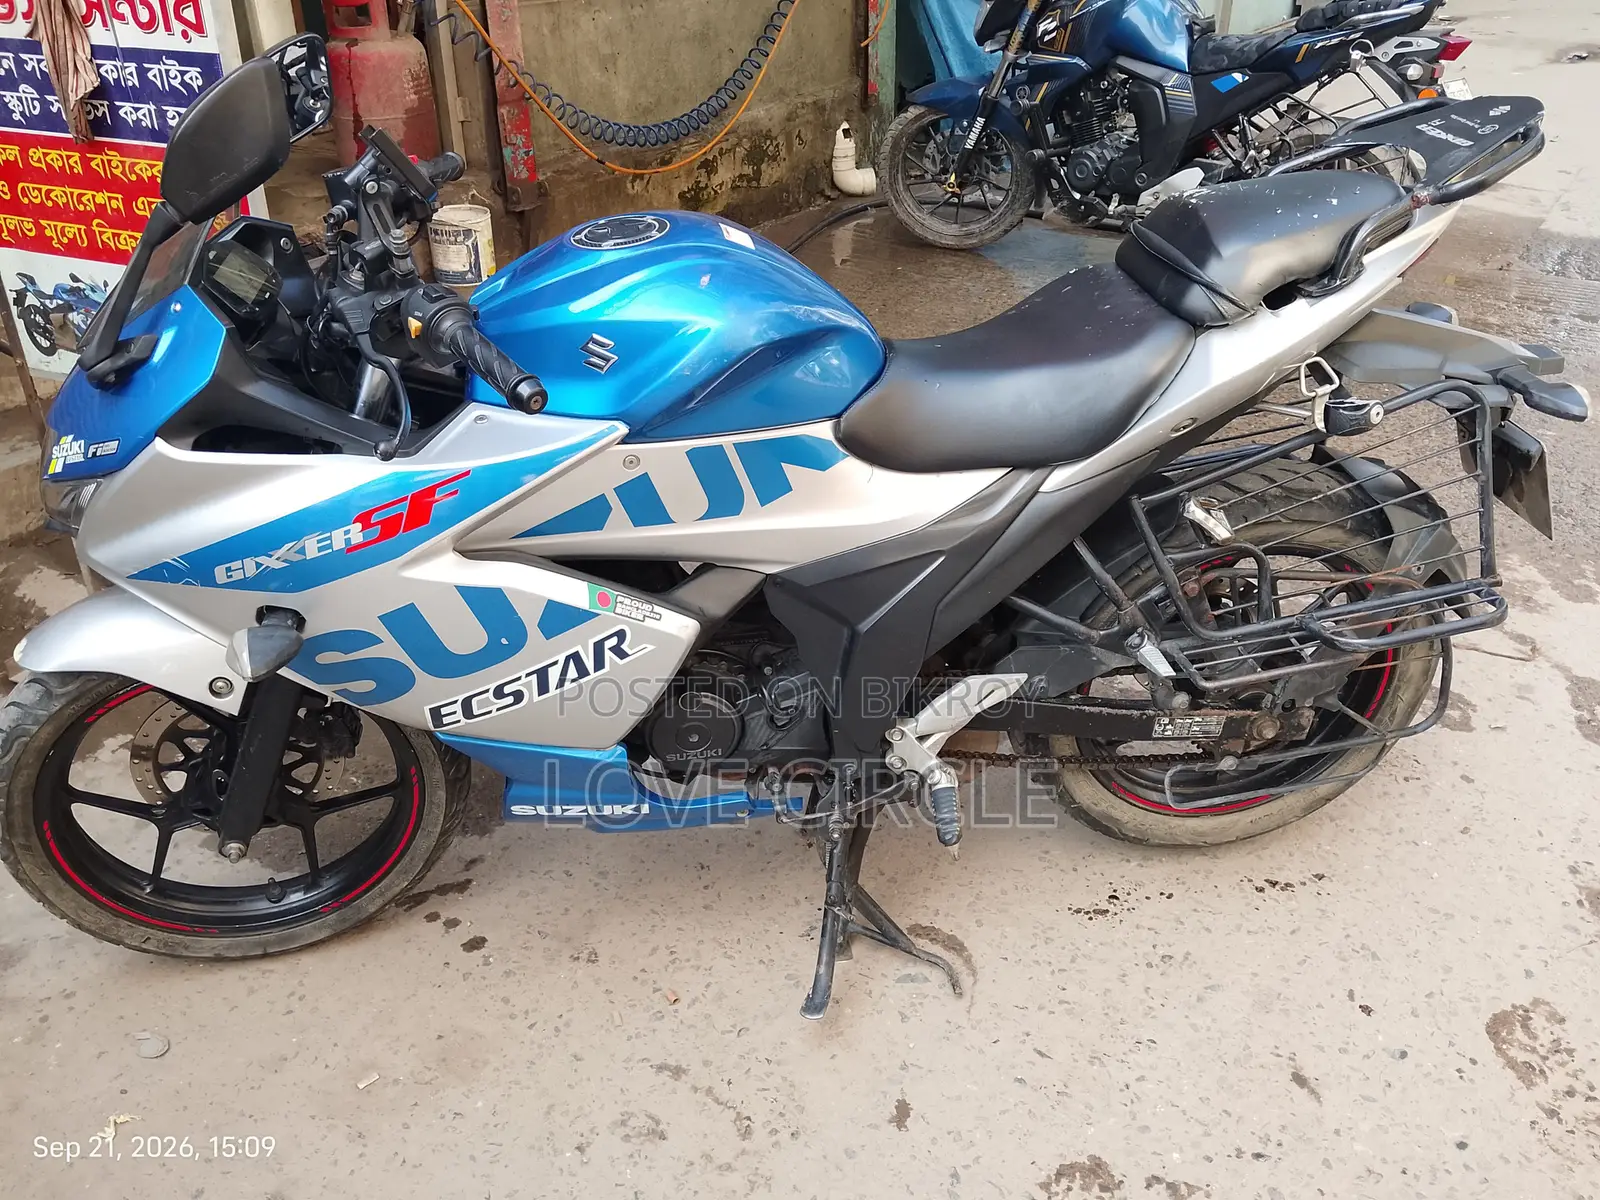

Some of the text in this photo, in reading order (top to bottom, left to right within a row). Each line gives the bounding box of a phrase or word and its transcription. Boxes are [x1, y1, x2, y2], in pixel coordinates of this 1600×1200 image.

[143, 55, 203, 95] বাইক
[114, 100, 159, 132] করা
[964, 116, 986, 150] YAMAHA
[28, 146, 83, 176] প্রকার
[17, 182, 126, 218] ডেকোরেশন
[52, 440, 84, 458] SUZUKI
[344, 469, 472, 555] SF
[616, 595, 654, 612] PROUD
[427, 627, 651, 731] ECSTAR
[665, 748, 723, 763] SUZUKI
[510, 803, 650, 817] SUZUKI
